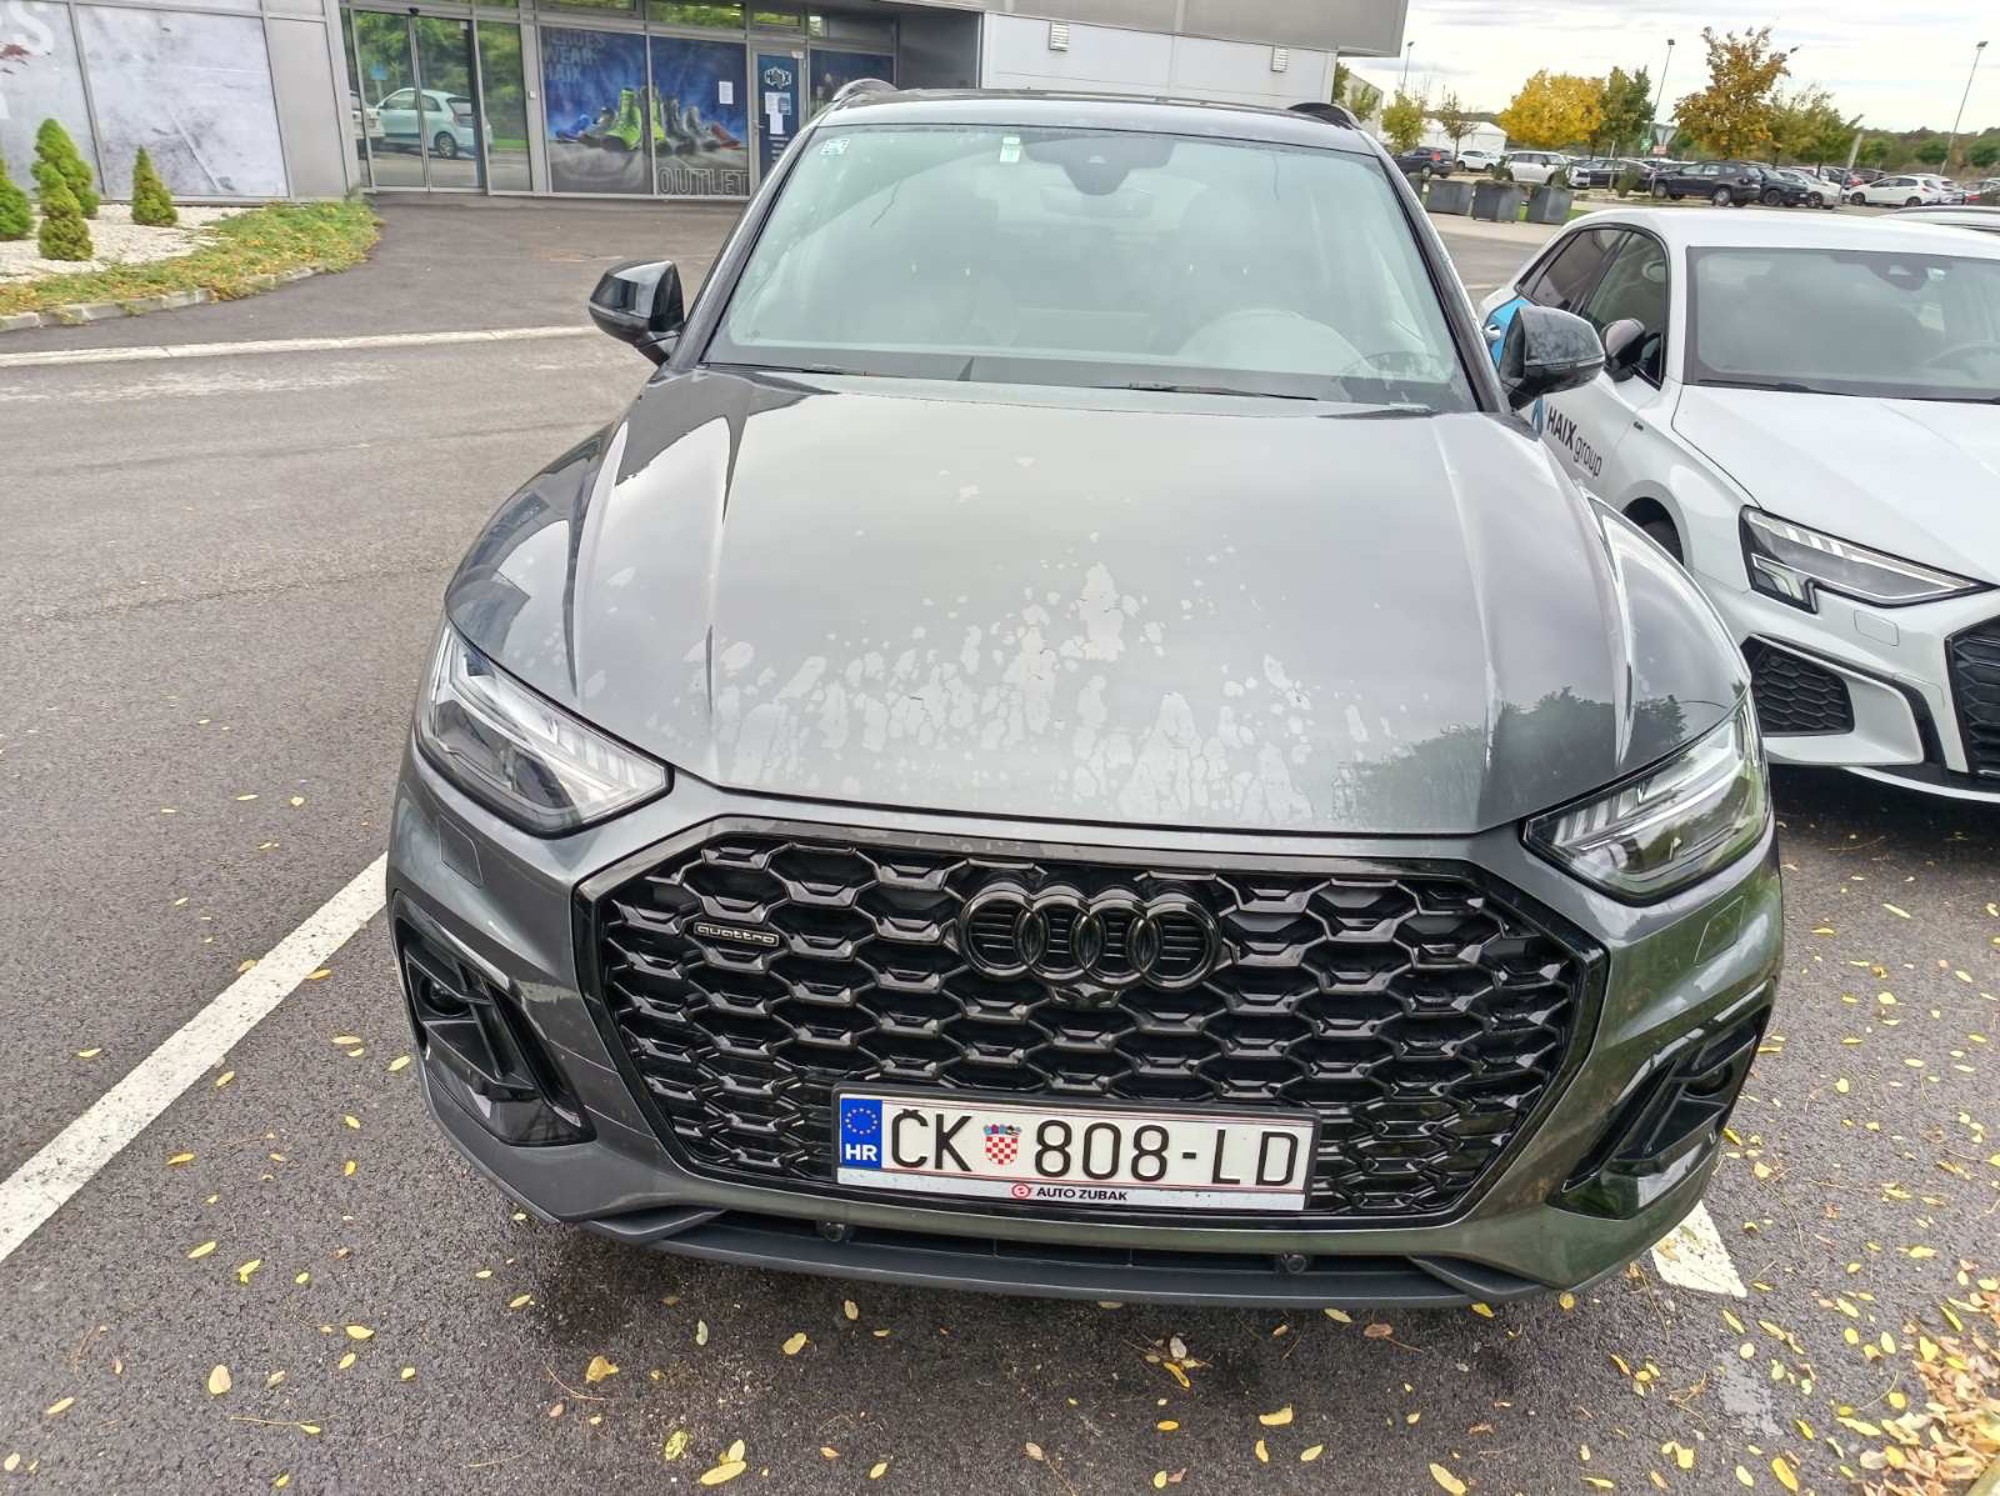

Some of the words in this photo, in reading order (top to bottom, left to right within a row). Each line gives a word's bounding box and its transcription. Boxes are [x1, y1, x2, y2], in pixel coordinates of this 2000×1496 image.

[658, 167, 750, 196] OUTLET
[1547, 406, 1578, 450] HAIX
[1573, 437, 1602, 477] group
[697, 926, 775, 944] quattro
[845, 1143, 878, 1162] HR
[1037, 1187, 1076, 1198] AUTO
[1079, 1189, 1128, 1200] ZUBAK
